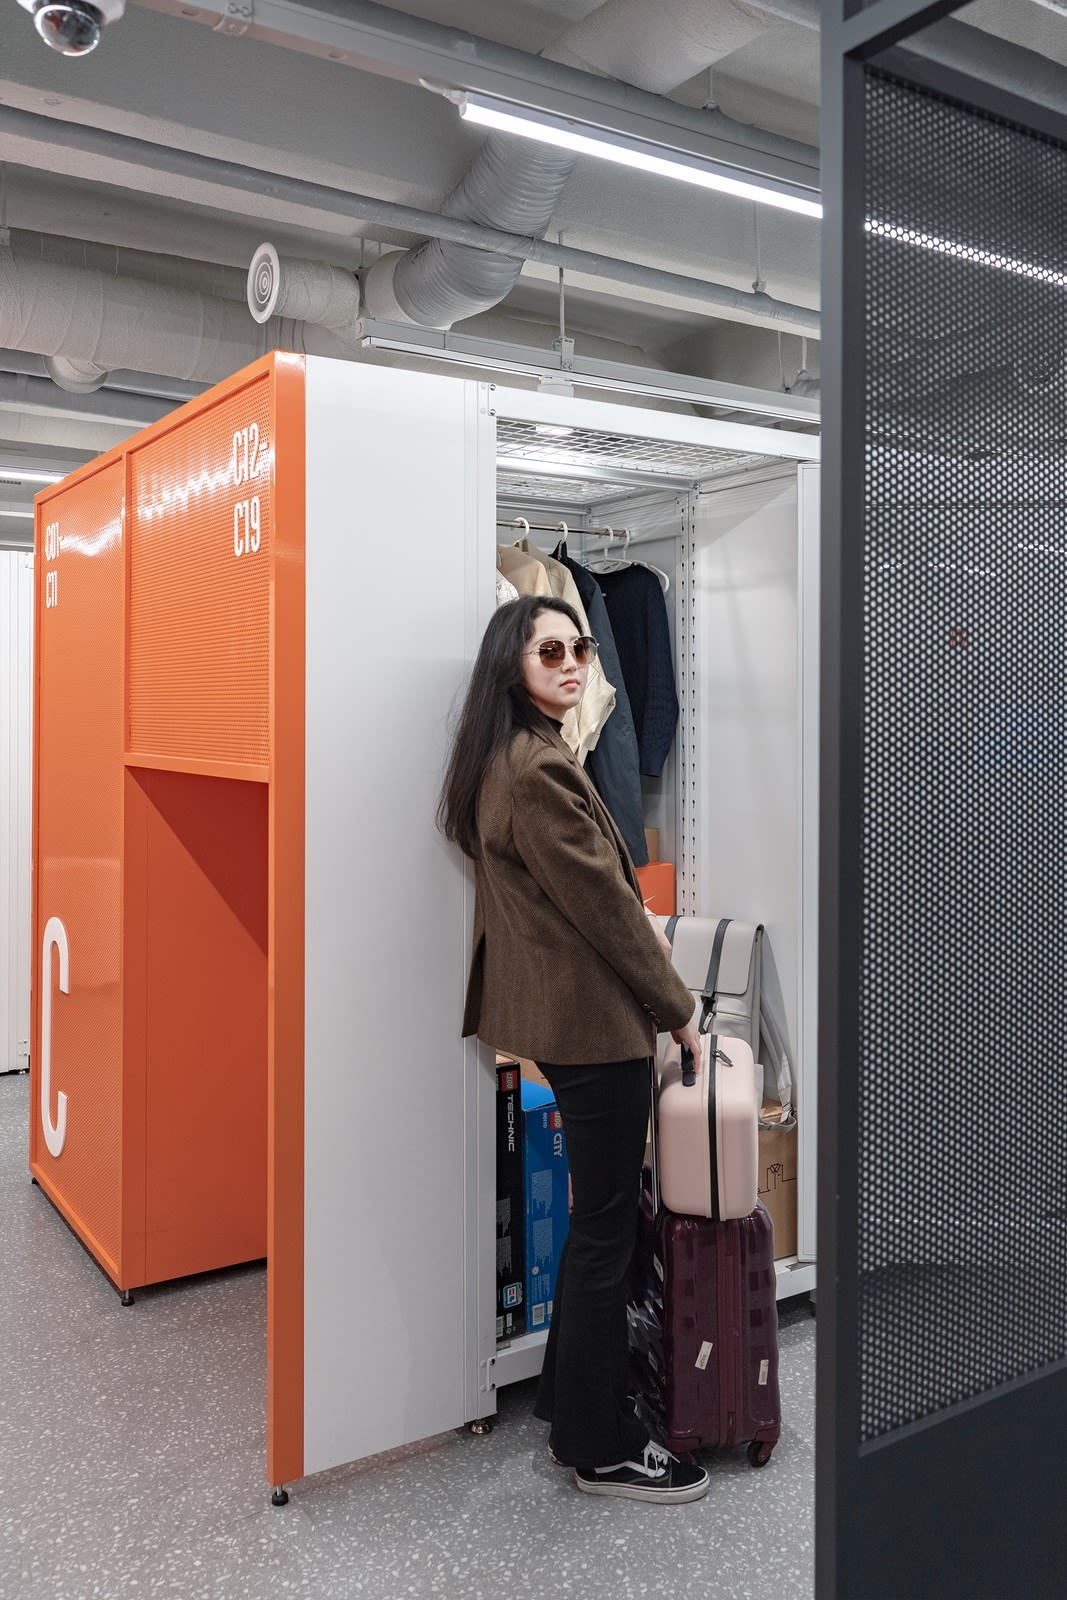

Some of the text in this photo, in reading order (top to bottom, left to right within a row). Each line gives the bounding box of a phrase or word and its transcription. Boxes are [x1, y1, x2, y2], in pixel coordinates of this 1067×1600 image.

[233, 495, 261, 557] C19
[46, 570, 58, 608] C11
[41, 916, 69, 1158] C
[507, 1093, 515, 1153] TECHNIC
[553, 1132, 563, 1158] CITY
